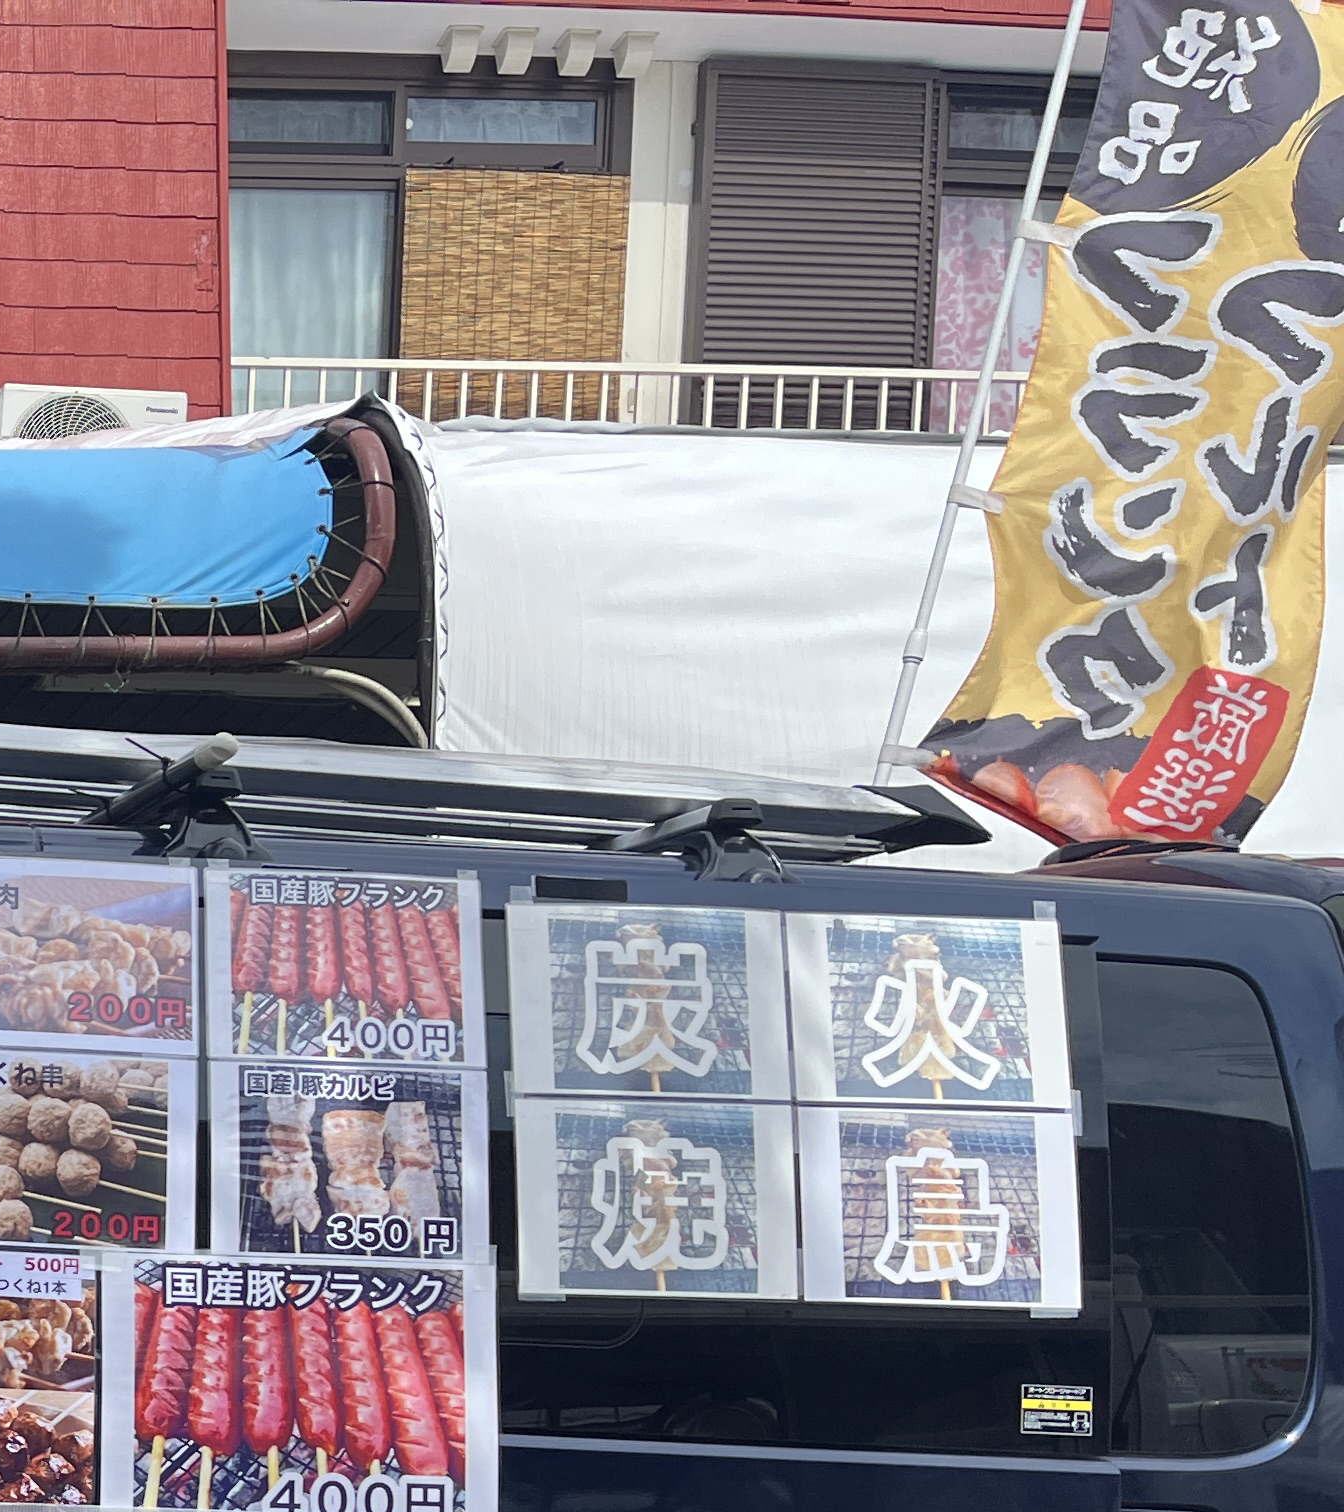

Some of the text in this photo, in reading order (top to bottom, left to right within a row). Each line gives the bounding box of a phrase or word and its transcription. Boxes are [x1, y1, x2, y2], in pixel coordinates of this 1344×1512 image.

[249, 877, 445, 911] 国産豚フランク
[68, 993, 187, 1029] 200円
[323, 1020, 454, 1054] 400円
[54, 1211, 161, 1243] 200円
[24, 1256, 80, 1275] 500円
[164, 1266, 446, 1312] 国産豚フランク
